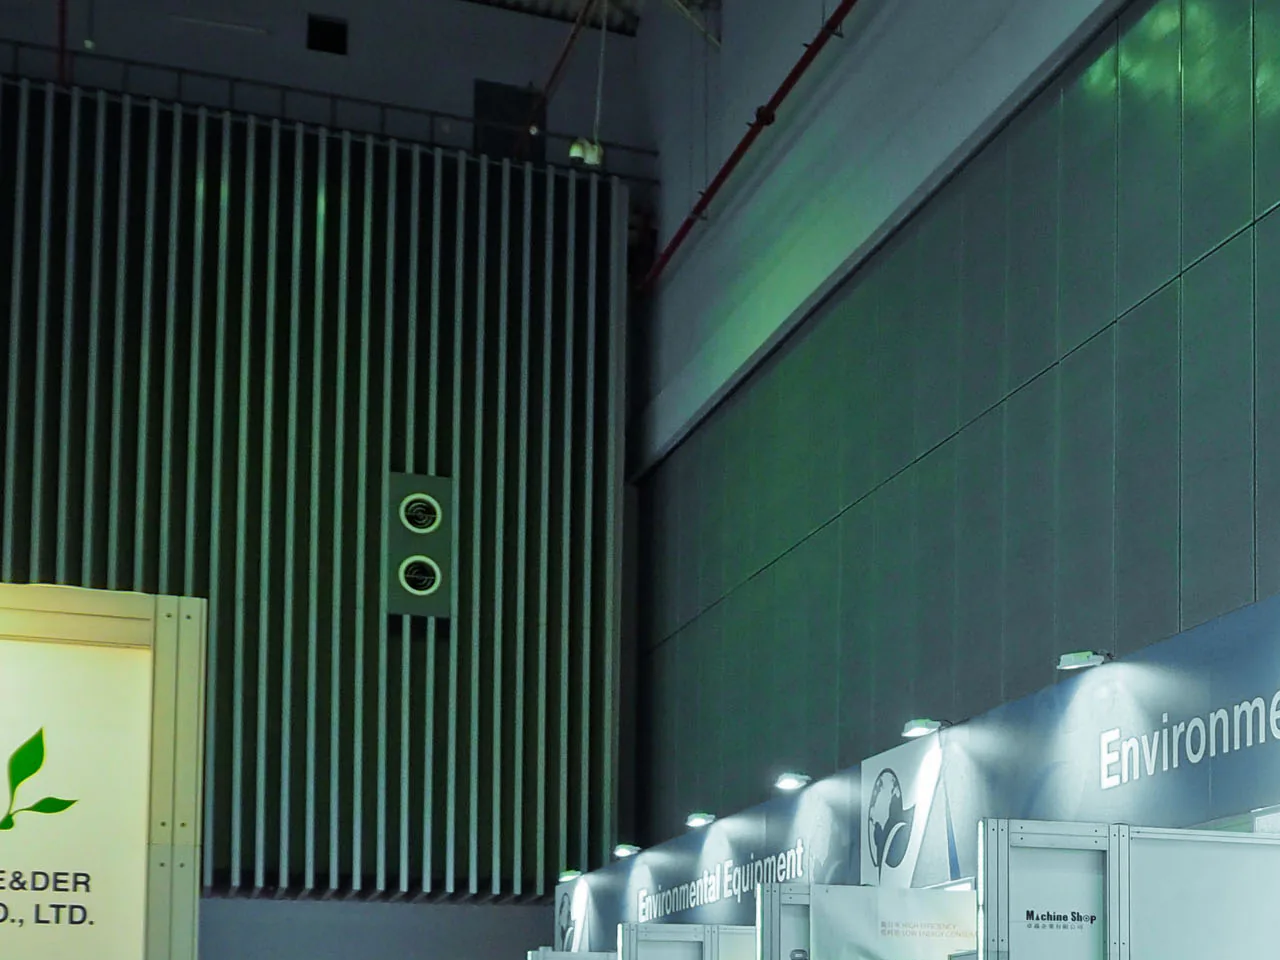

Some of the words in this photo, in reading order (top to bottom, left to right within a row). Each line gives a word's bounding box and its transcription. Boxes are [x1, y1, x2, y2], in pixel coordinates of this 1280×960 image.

[638, 864, 720, 923] Environmental
[724, 838, 804, 902] Equipment
[34, 904, 94, 925] LTD.
